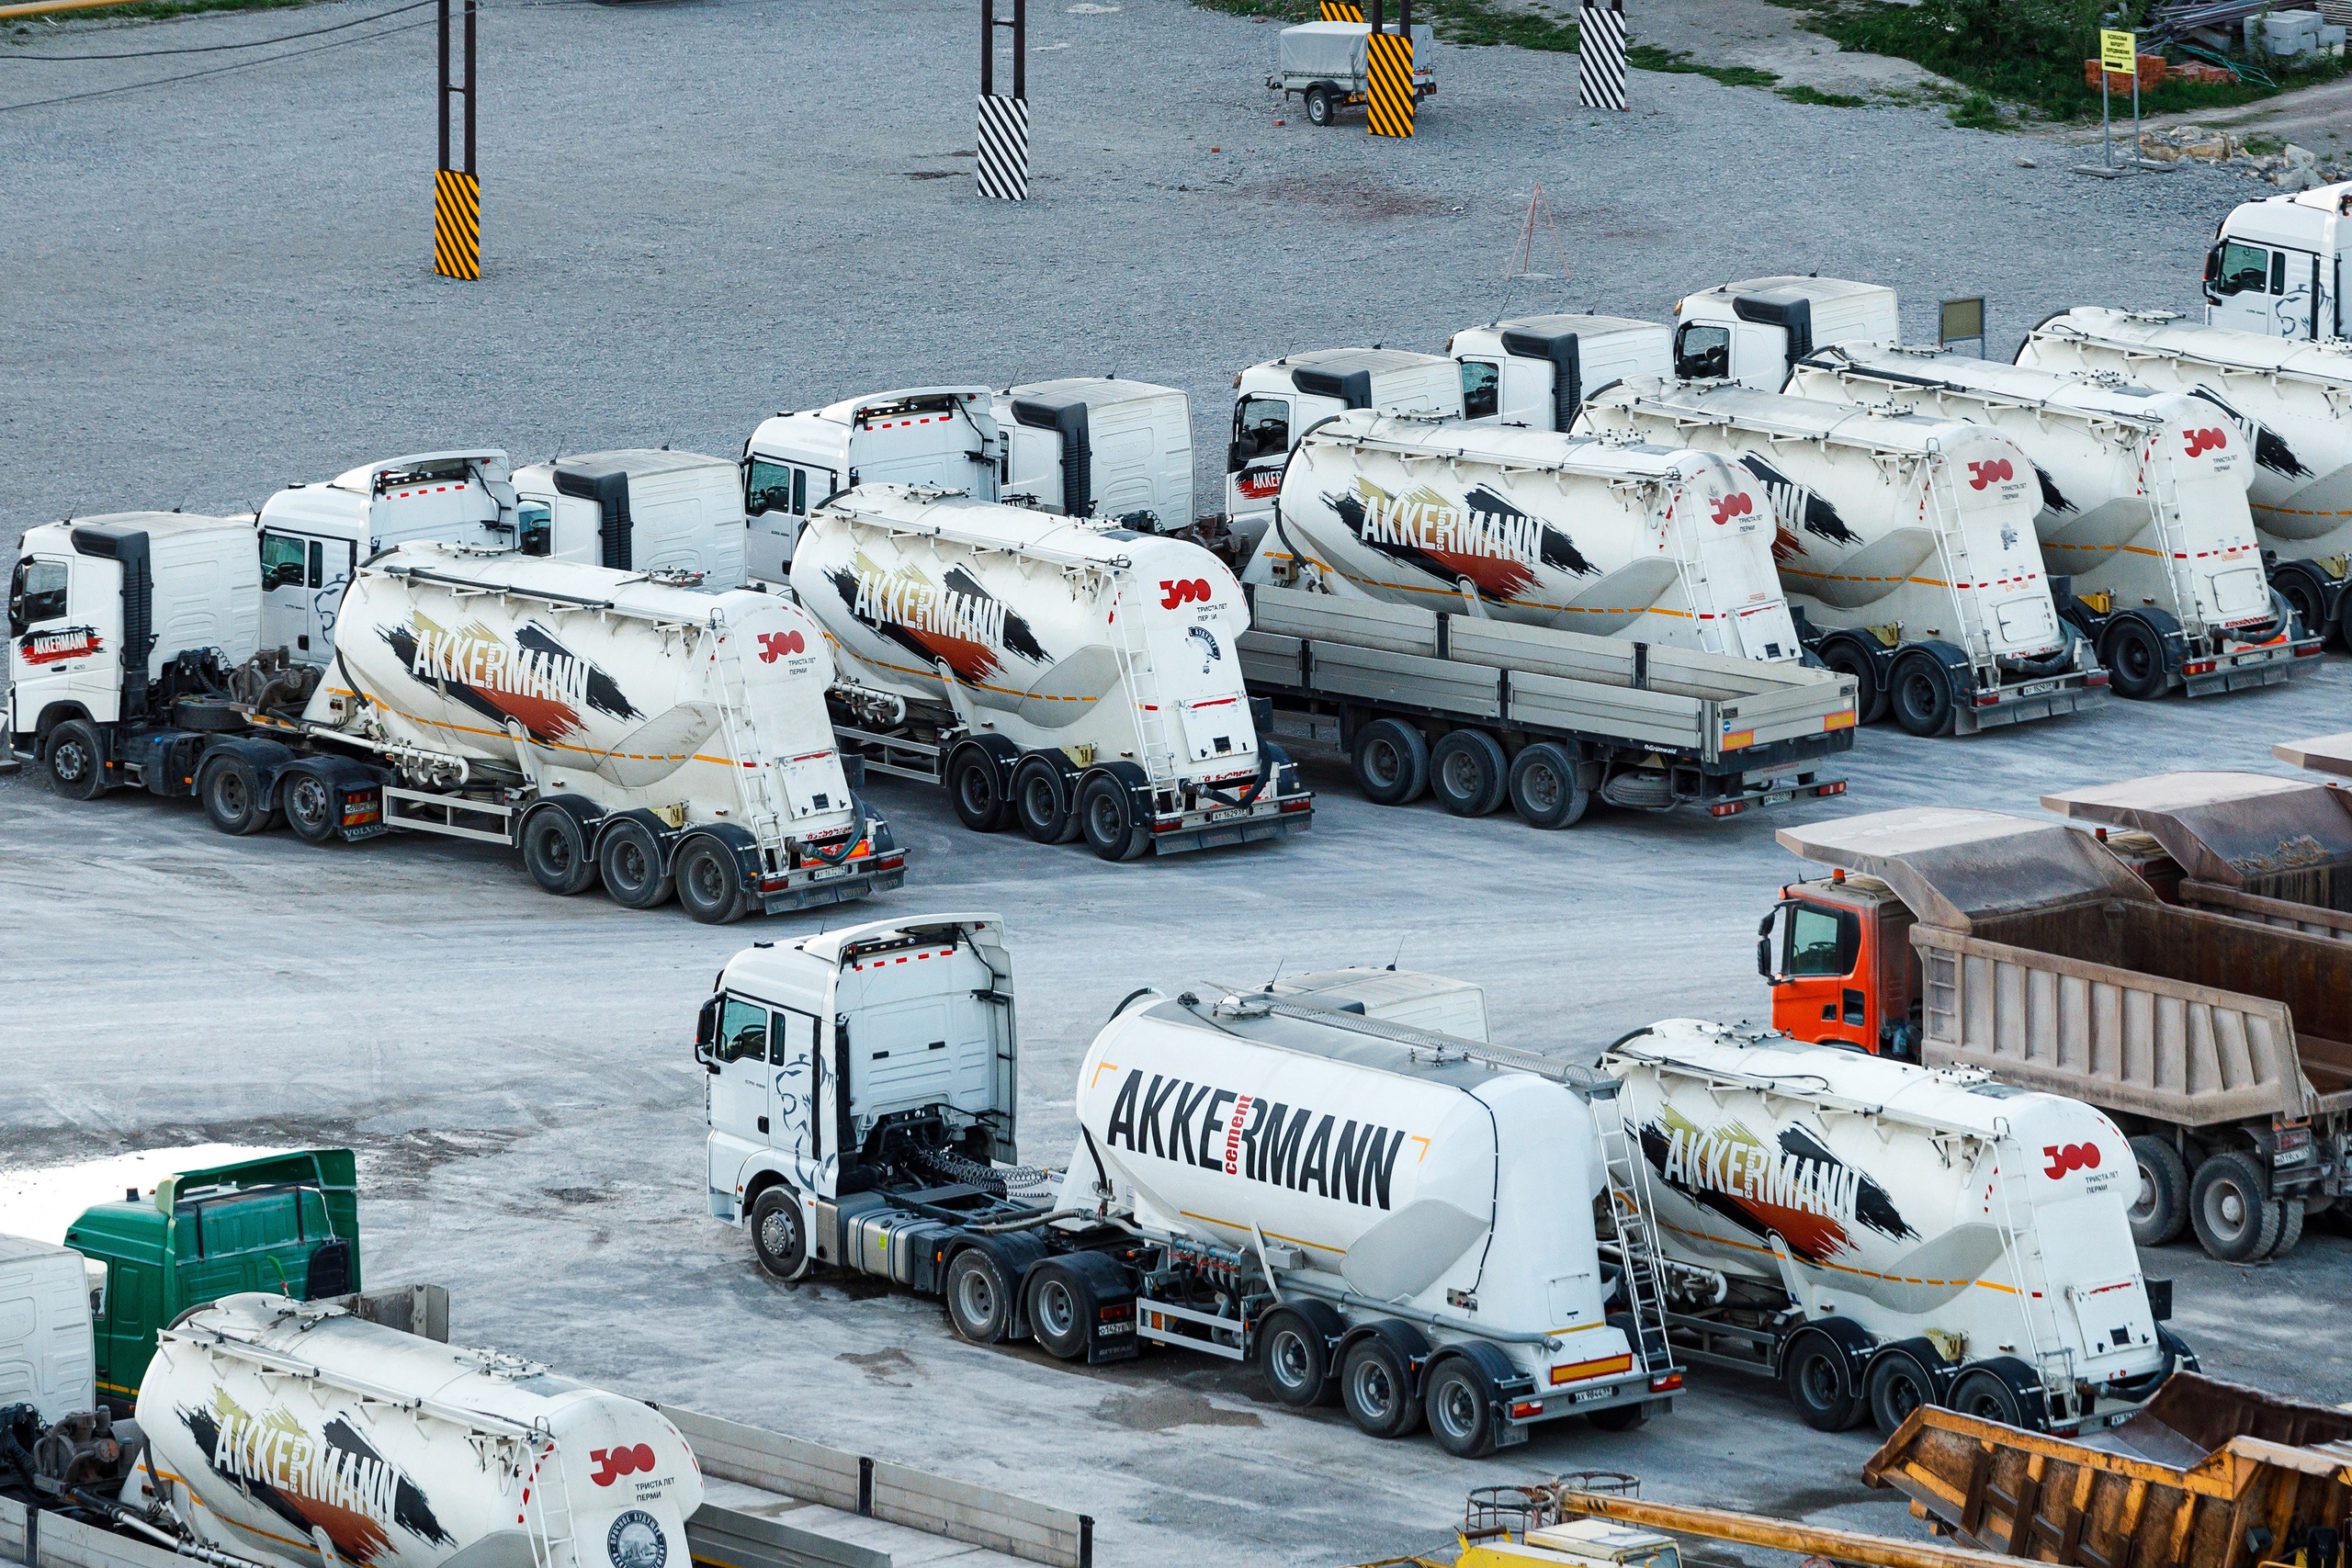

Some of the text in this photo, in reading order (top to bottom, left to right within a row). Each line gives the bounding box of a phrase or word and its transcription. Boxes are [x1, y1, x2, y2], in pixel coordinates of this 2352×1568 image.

[1253, 470, 1283, 489] AKKER
[1361, 496, 1545, 564] AKKERMANN
[854, 570, 1008, 648] AKKERMANN
[33, 631, 88, 655] AKKERMANN
[413, 628, 592, 706] AKKERMANN
[788, 658, 808, 666] ТРИСТА
[344, 825, 381, 837] VOLVO
[1106, 1068, 1406, 1211] AKKERMANN
[1225, 1094, 1253, 1176] cement
[1664, 1128, 1862, 1221] AKKERMANN
[2085, 1174, 2109, 1183] ТРИСТА
[2086, 1184, 2108, 1194] ПЕРМИ
[214, 1414, 401, 1522] AKKERMANN
[635, 1480, 662, 1491] ТРИСТА
[636, 1491, 662, 1502] ПЕРМИ
